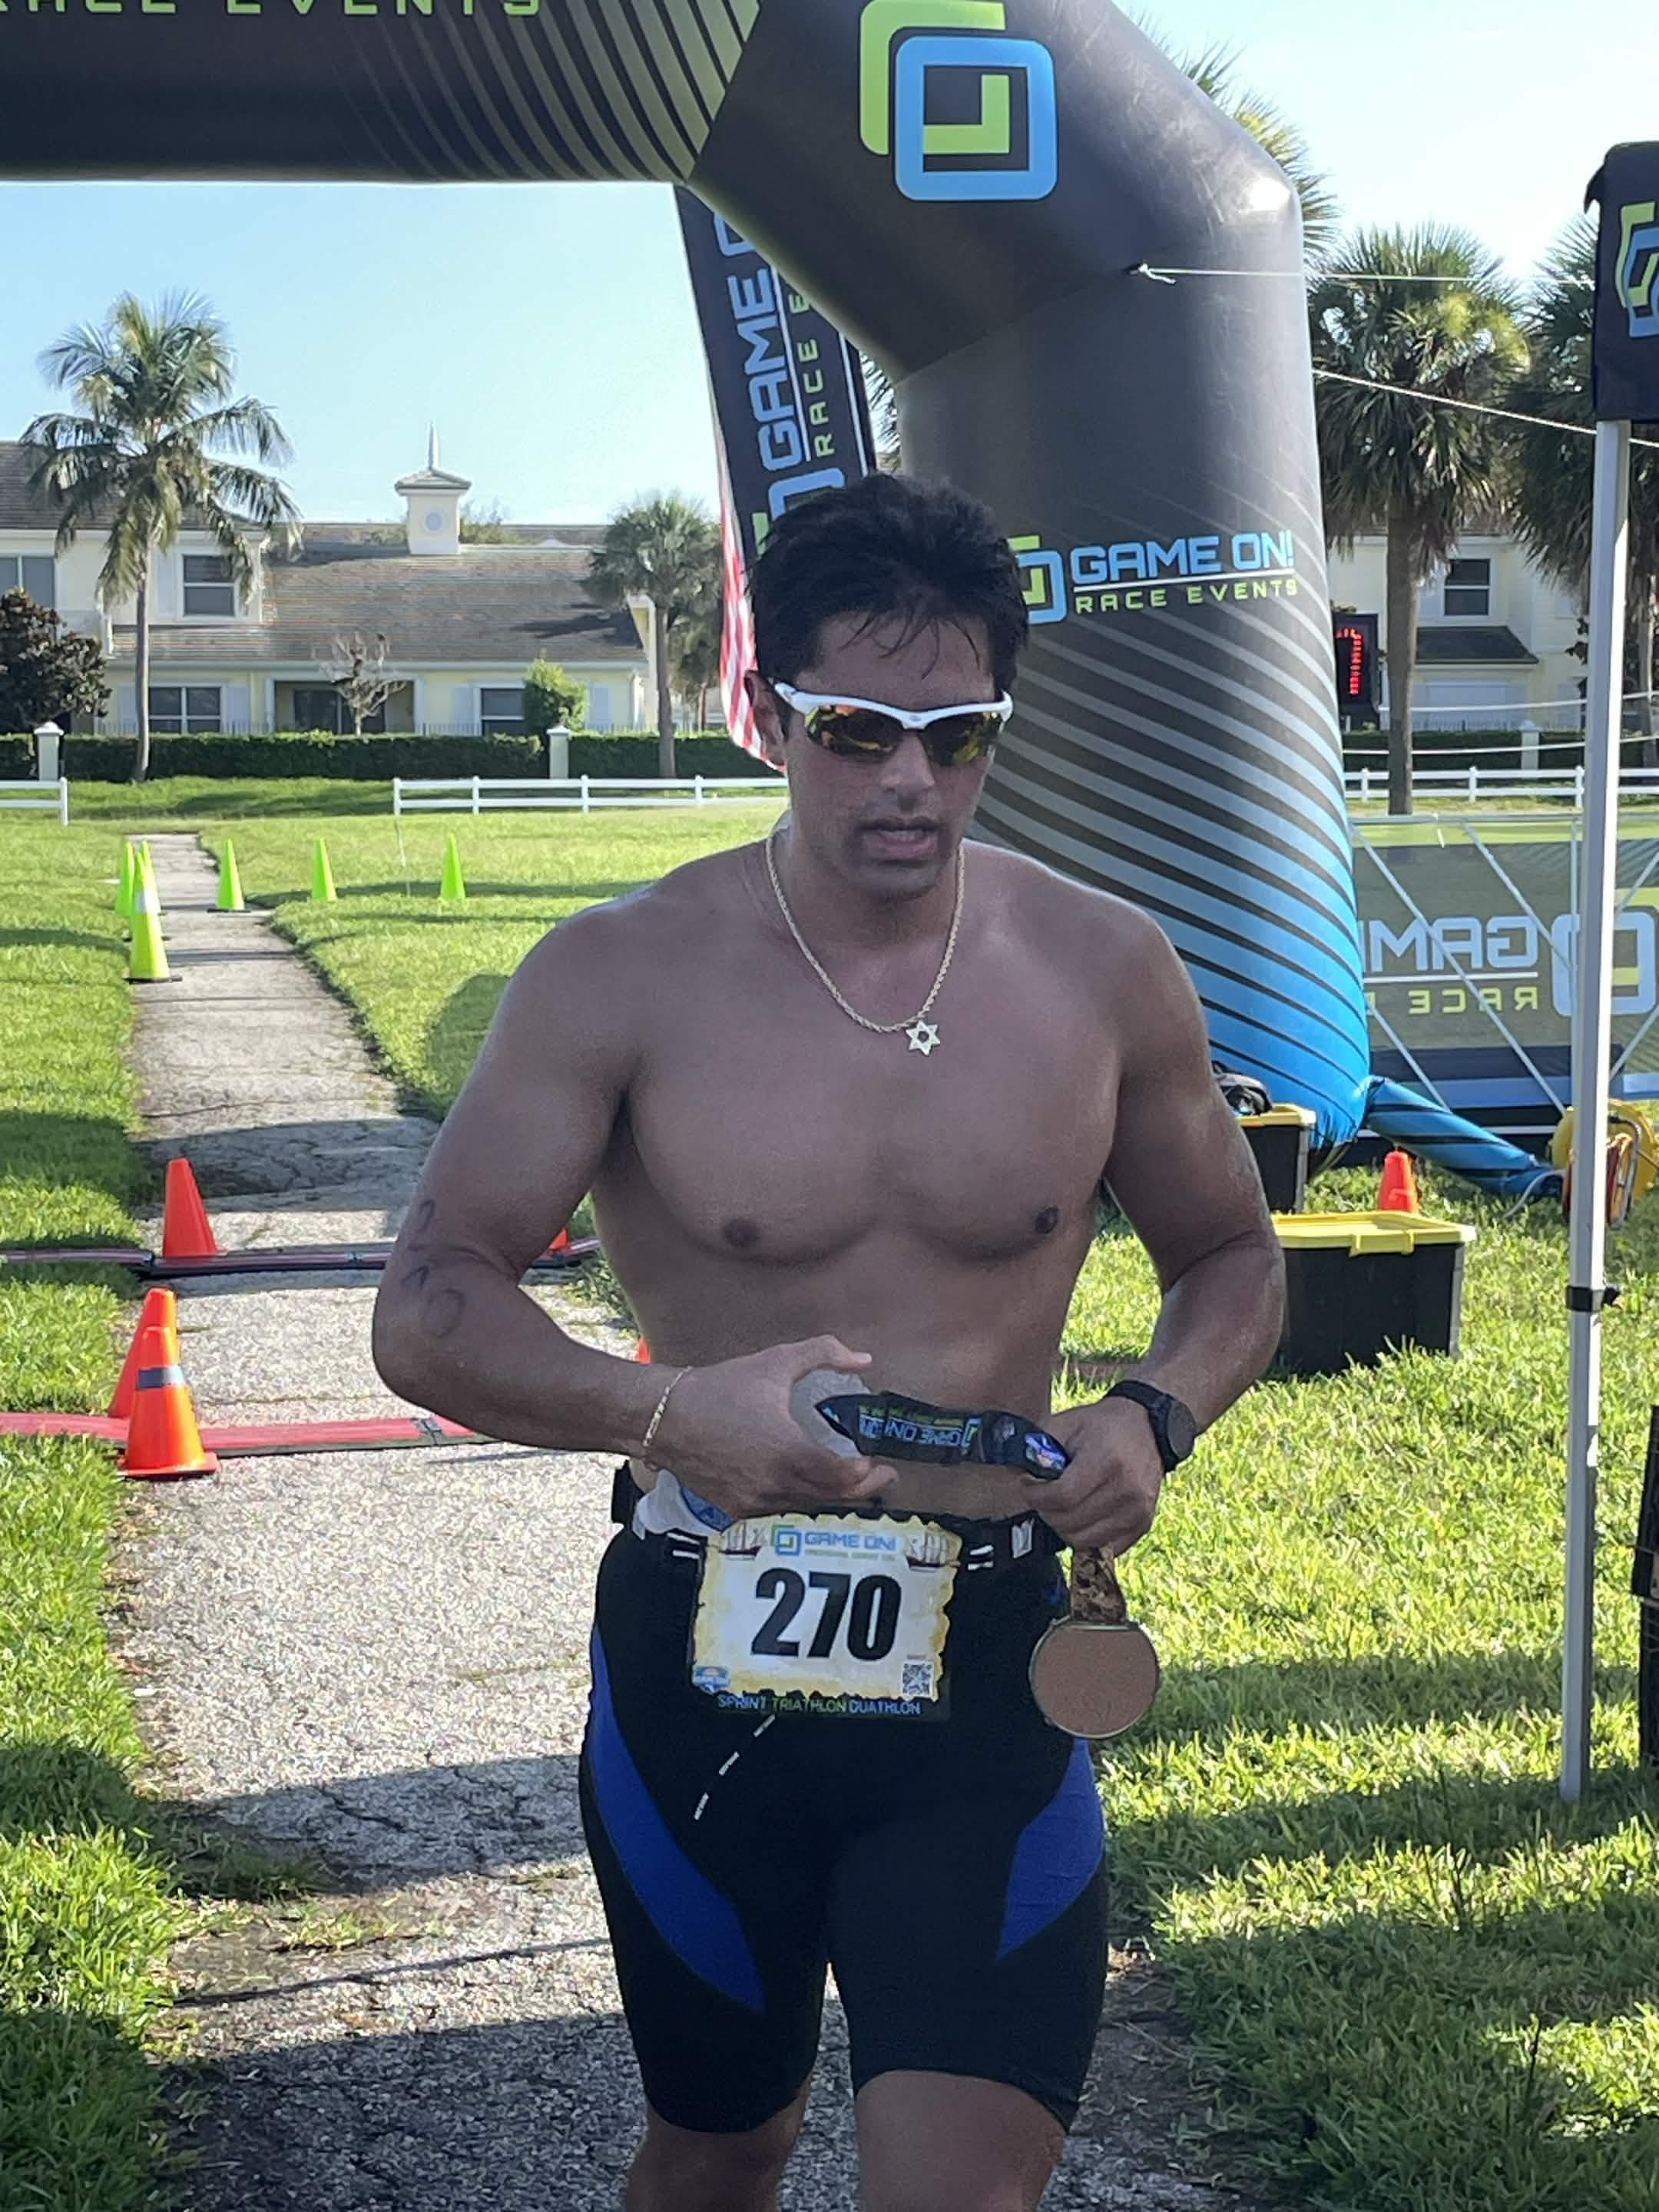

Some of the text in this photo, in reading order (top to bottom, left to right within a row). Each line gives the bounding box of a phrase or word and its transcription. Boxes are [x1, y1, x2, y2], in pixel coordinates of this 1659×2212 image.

[727, 267, 803, 472] GAME
[796, 338, 835, 458] RACE
[1071, 530, 1294, 584] GAME ON!
[1075, 578, 1299, 614] RACE EVENTS
[805, 1532, 860, 1548] GAME
[750, 1567, 902, 1661] 270
[717, 1694, 921, 1715] SPRINT TRIATHLON DUATHLON
